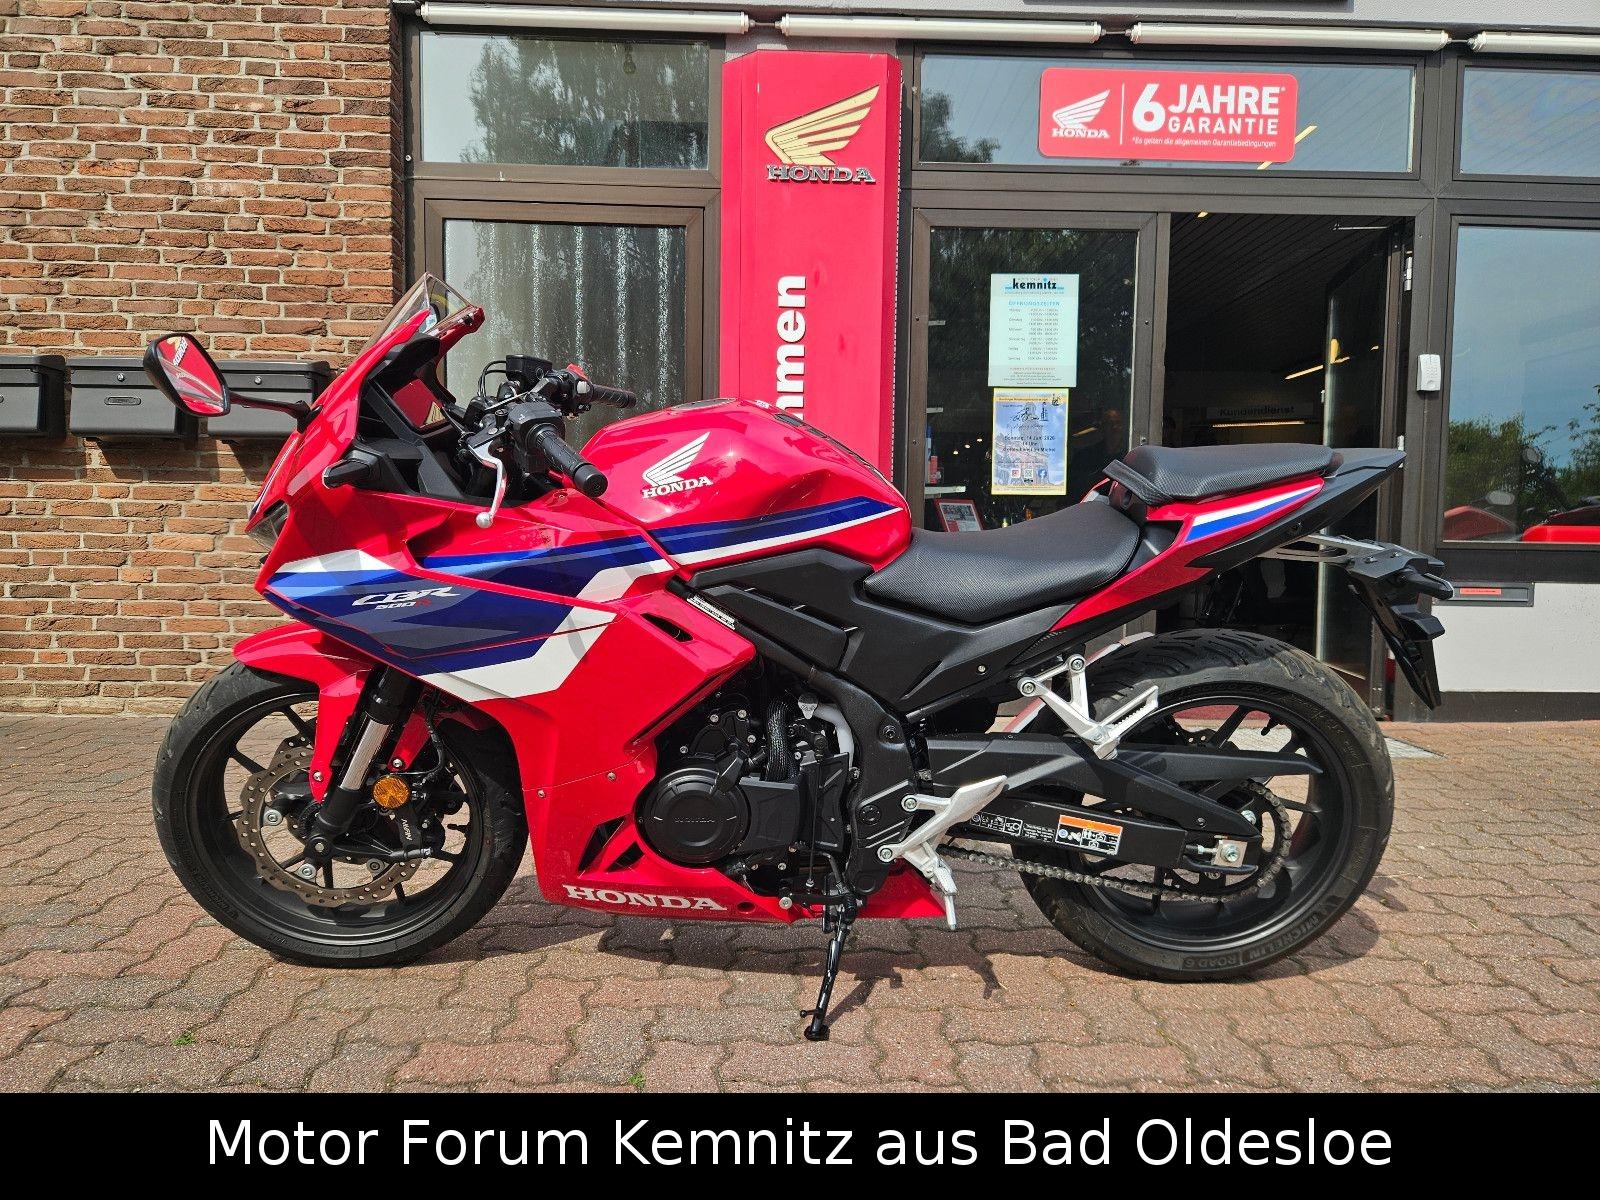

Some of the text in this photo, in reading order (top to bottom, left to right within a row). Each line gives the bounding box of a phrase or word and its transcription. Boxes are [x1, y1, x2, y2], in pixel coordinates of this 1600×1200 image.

[1131, 82, 1167, 133] 6
[1051, 127, 1110, 139] HONDA
[1168, 116, 1279, 136] GARANTIE
[1163, 138, 1174, 146] die
[766, 163, 876, 185] HONDA
[1012, 278, 1058, 290] kemnitz
[641, 476, 714, 499] HONDA
[351, 586, 461, 606] CBR
[562, 884, 728, 911] HONDA
[1248, 911, 1320, 960] MICHELIN
[1198, 954, 1240, 969] ROAD
